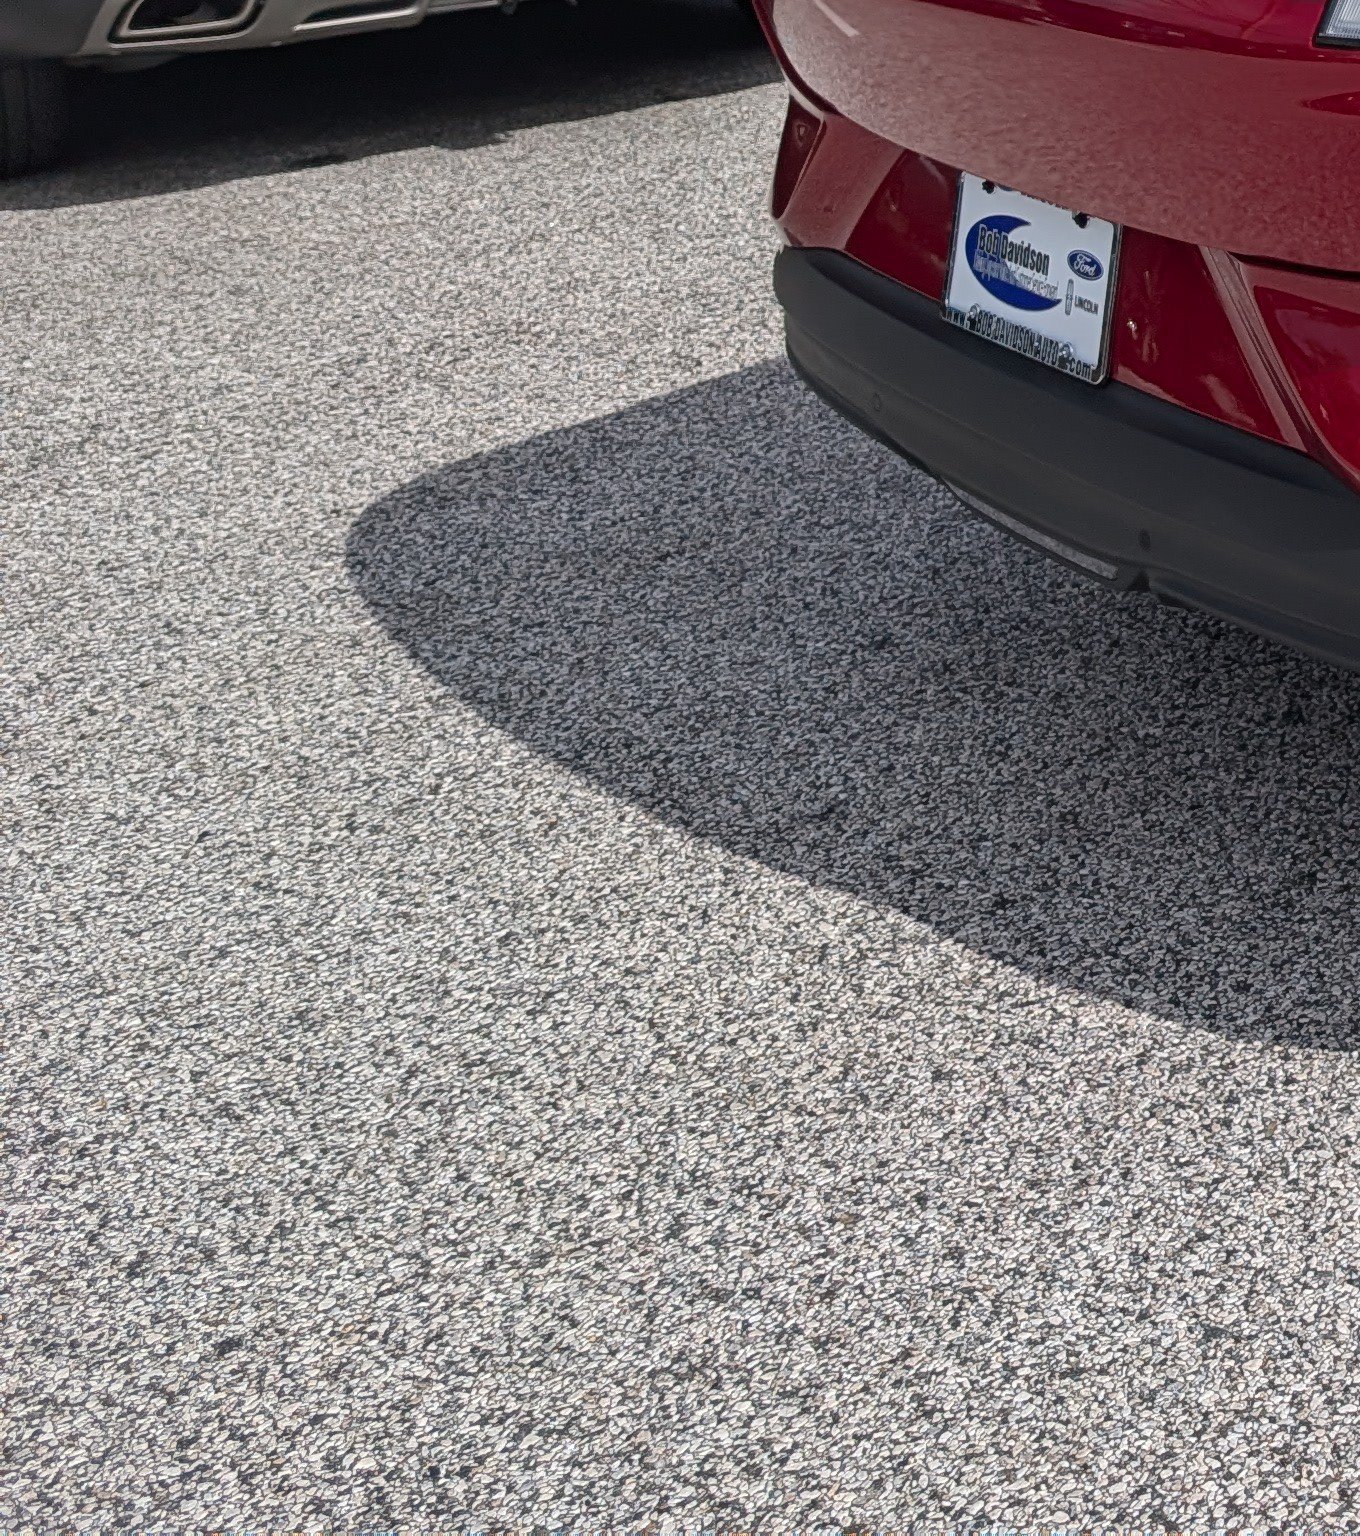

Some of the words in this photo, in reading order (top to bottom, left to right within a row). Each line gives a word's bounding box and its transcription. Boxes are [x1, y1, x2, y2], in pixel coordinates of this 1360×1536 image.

[978, 225, 1001, 257] Bob
[1001, 233, 1050, 277] Davidson
[1075, 253, 1096, 277] Ford
[1073, 294, 1099, 316] LINCOLN
